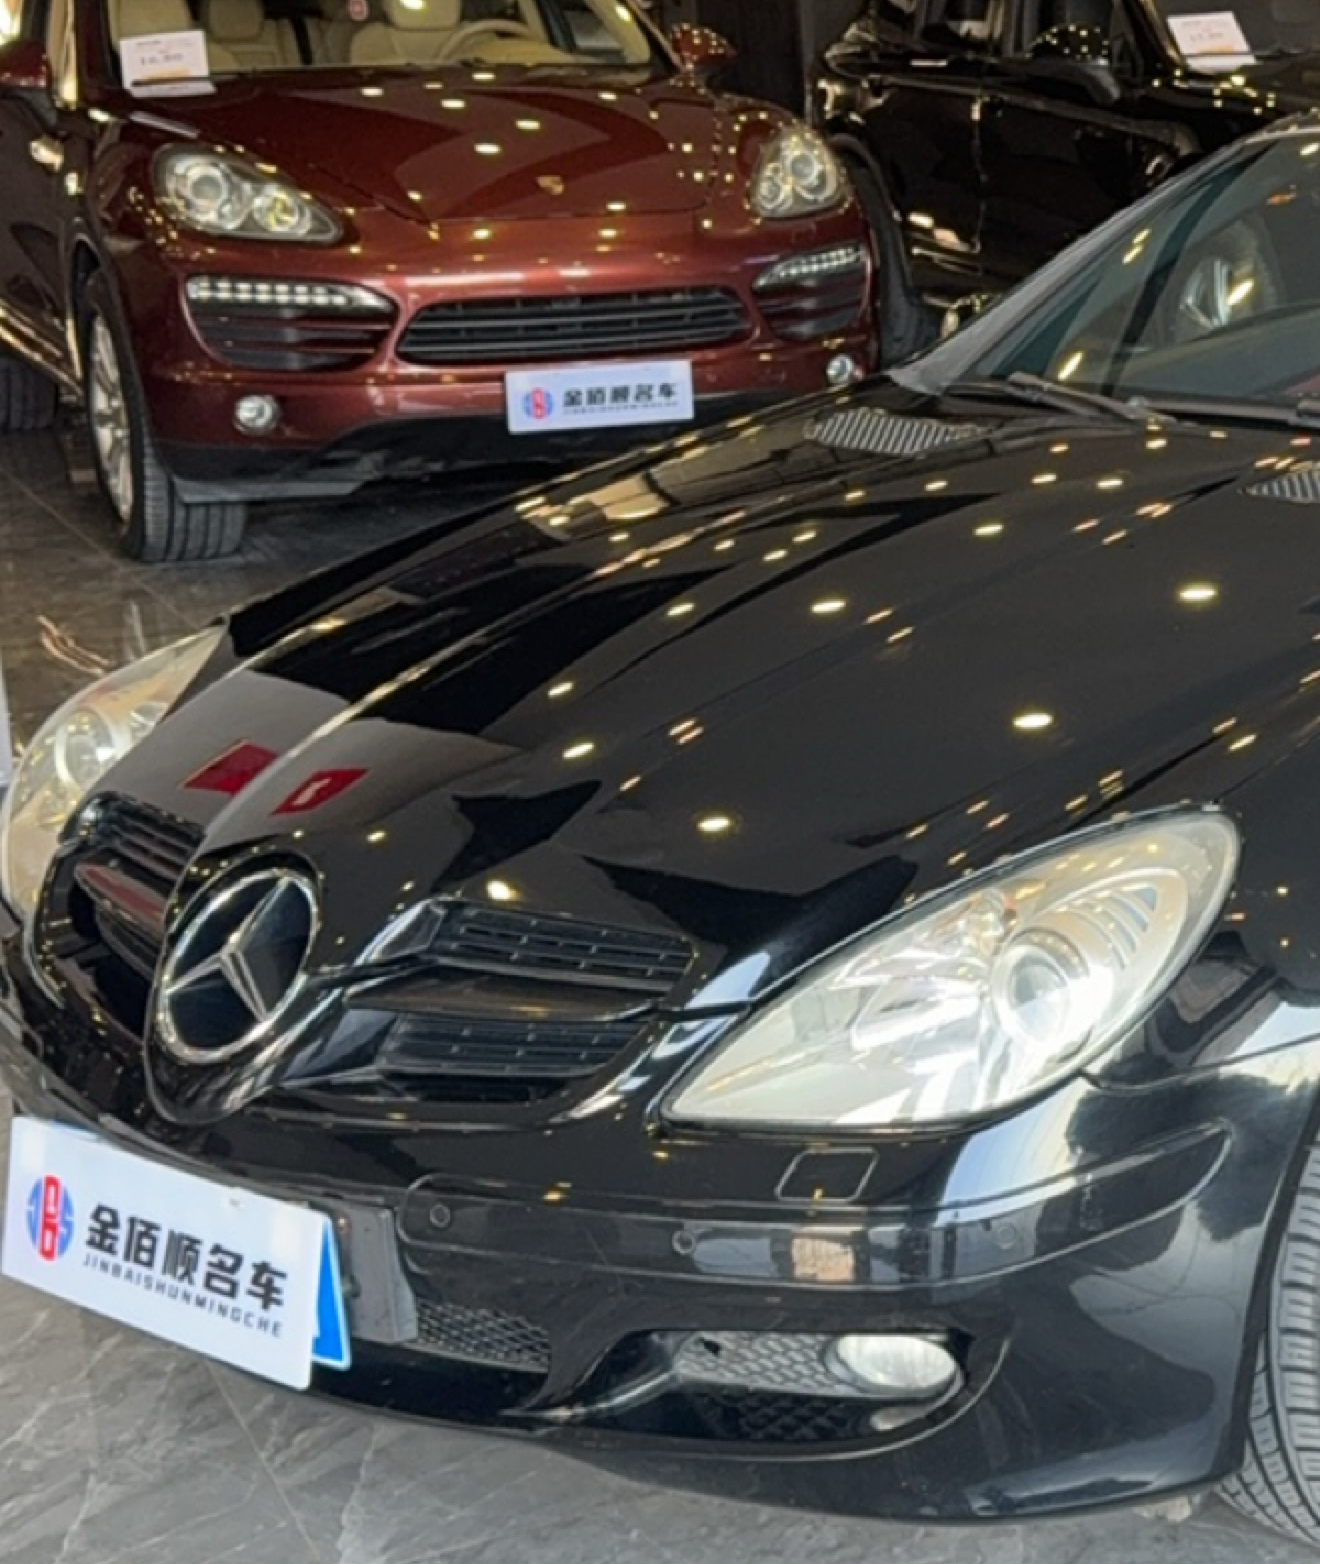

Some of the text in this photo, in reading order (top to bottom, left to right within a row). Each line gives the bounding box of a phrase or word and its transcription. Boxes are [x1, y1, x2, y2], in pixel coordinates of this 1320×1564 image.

[83, 1253, 284, 1338] JINBAISHUNMINGCHE
[85, 1203, 288, 1311] 金佰顺名车
